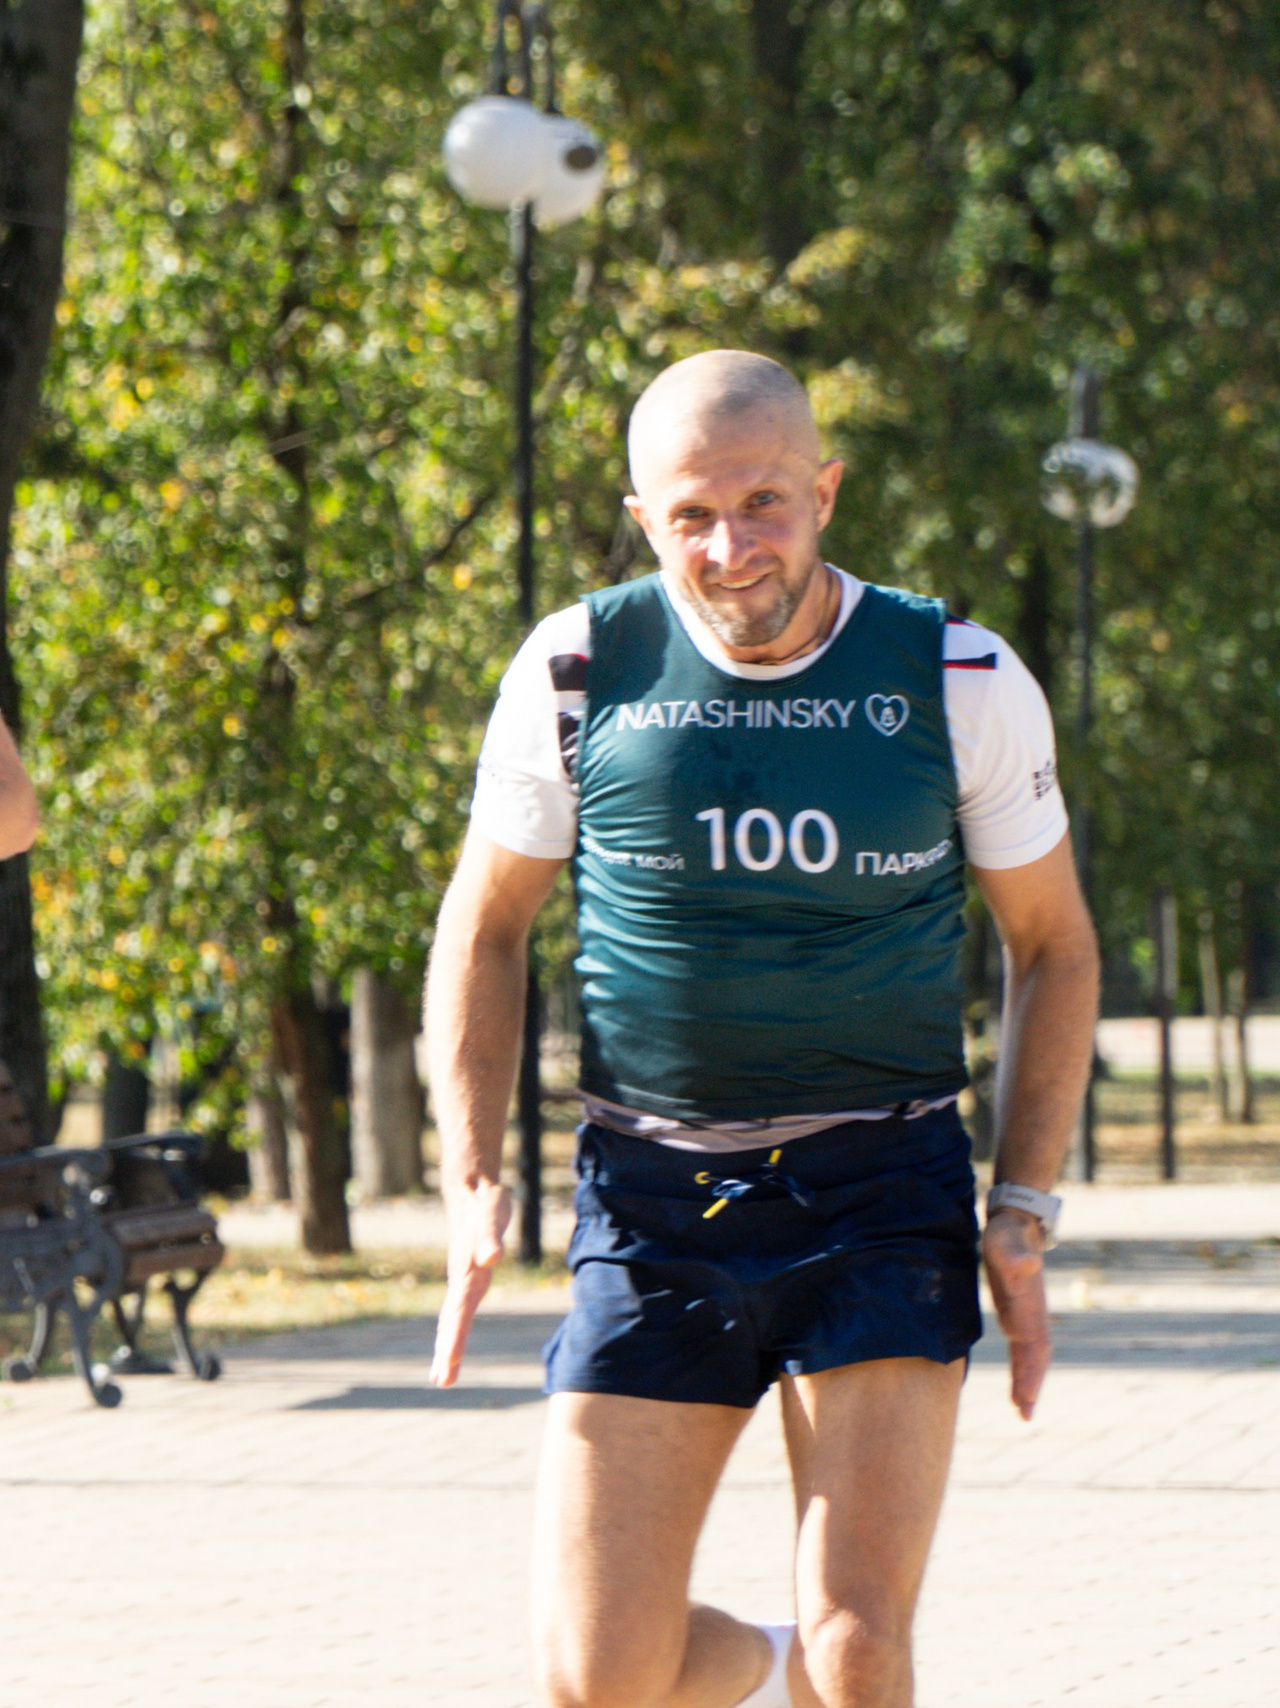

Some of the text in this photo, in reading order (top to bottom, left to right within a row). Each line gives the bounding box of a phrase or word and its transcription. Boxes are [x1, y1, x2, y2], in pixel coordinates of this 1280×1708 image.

[616, 698, 856, 731] NATASHINSKY
[635, 853, 686, 871] МОЙ
[695, 807, 839, 873] 100
